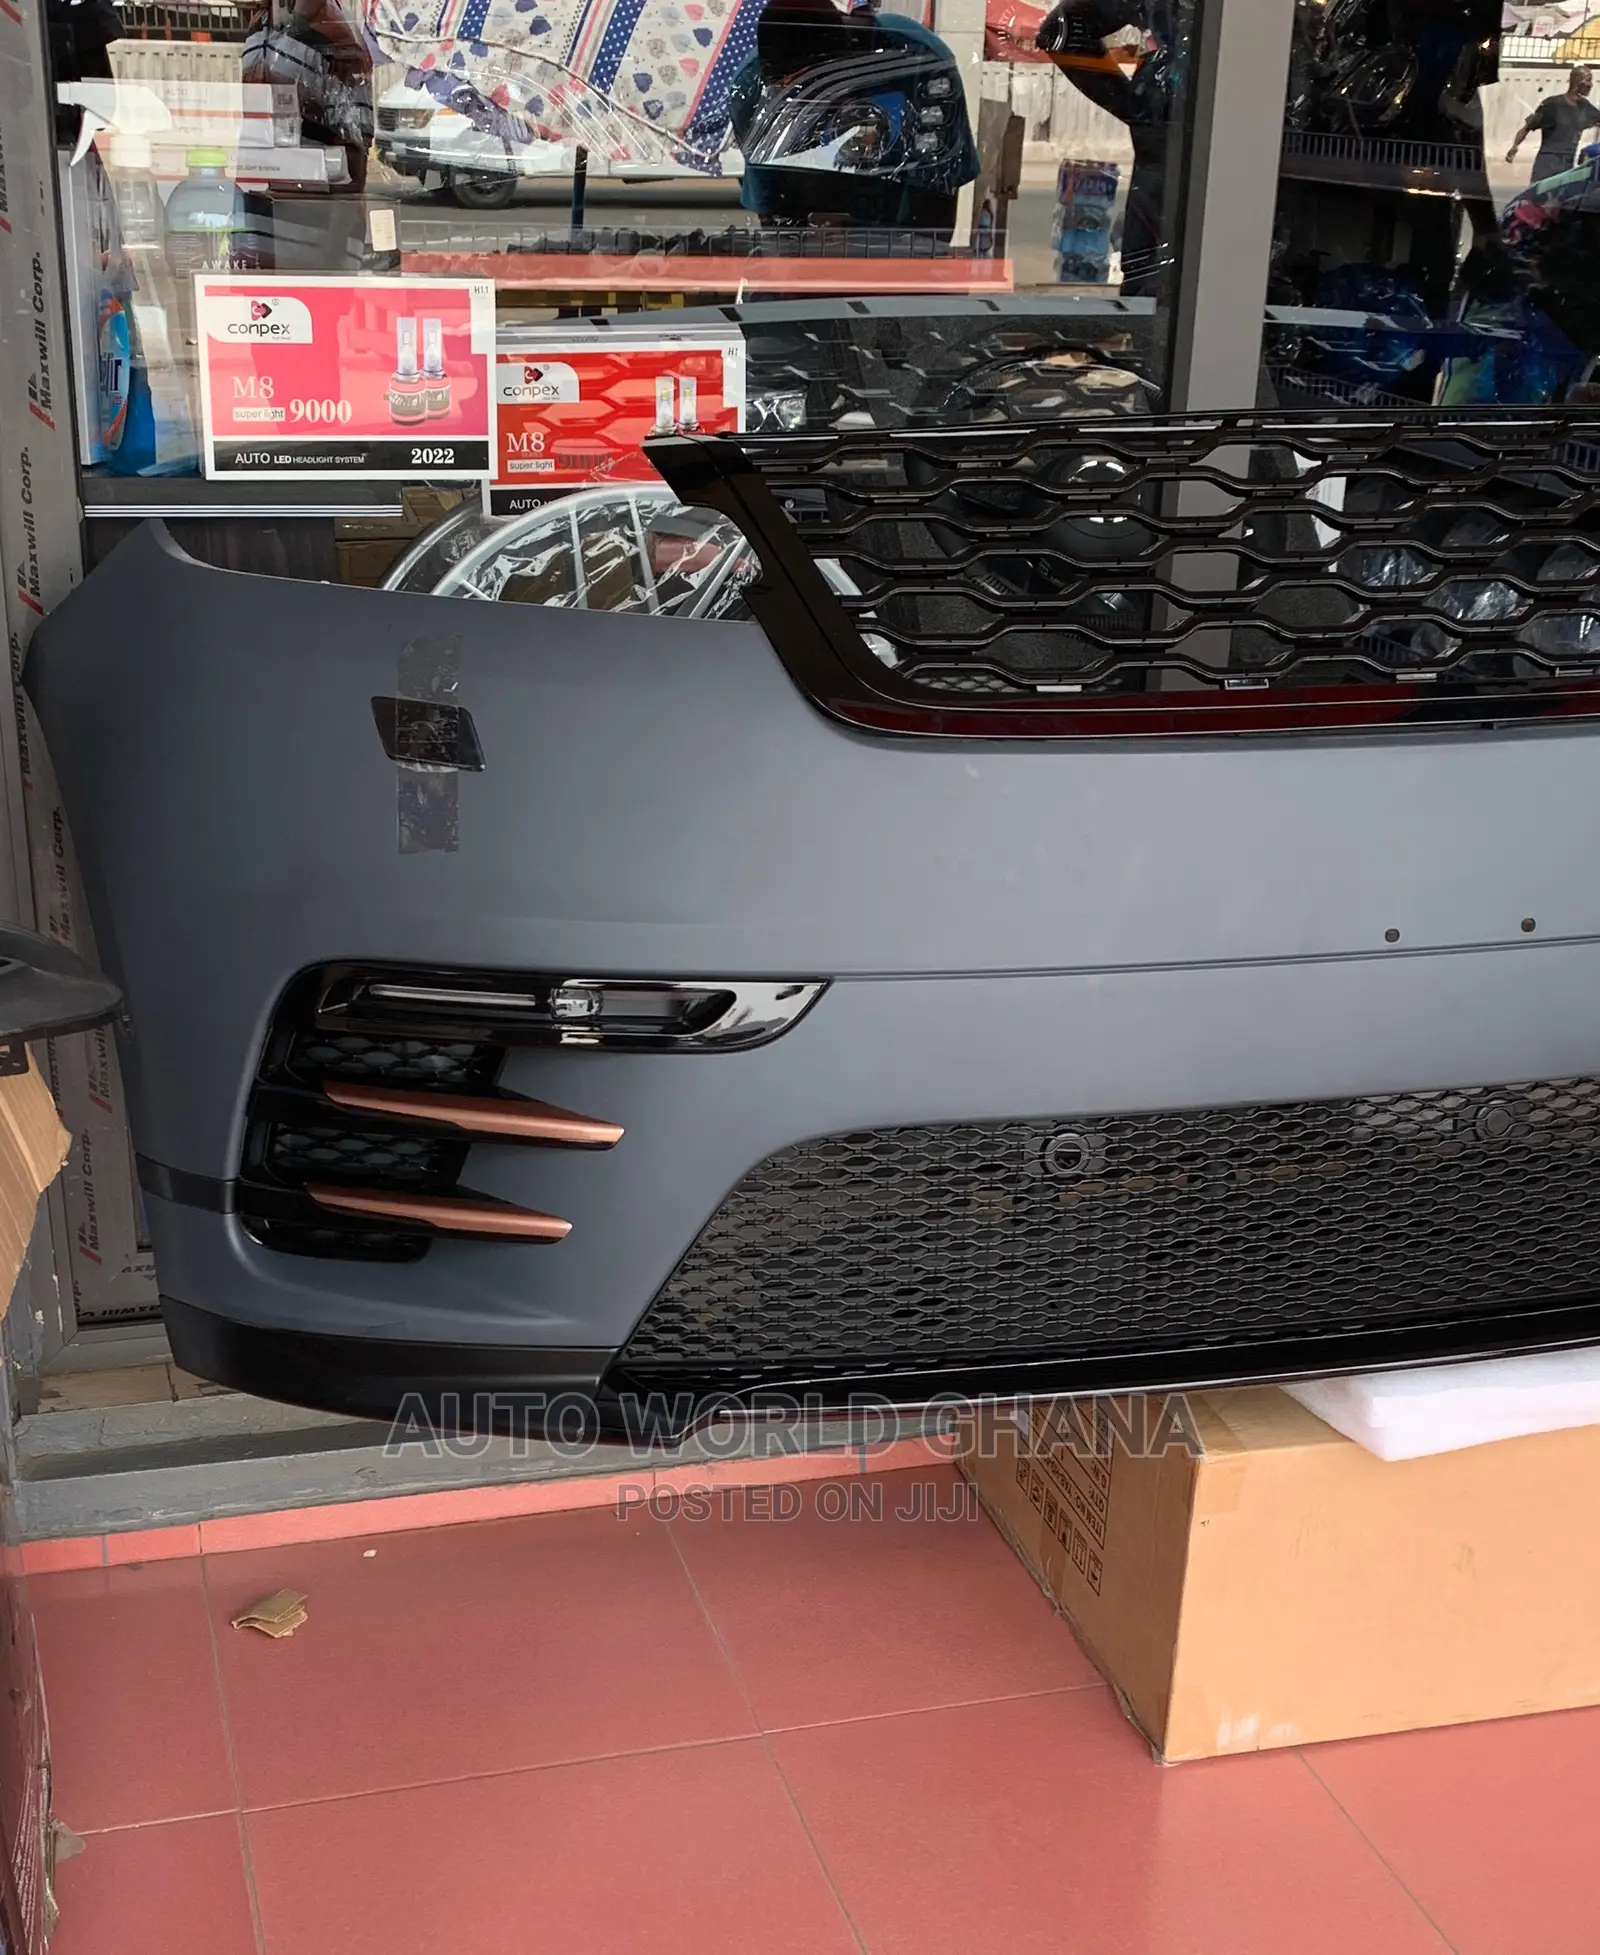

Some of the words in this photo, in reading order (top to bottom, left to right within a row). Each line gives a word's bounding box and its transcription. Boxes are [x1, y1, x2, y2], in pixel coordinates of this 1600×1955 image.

[202, 260, 247, 270] AWAKE
[32, 252, 46, 313] Corp.
[227, 323, 291, 337] conpex
[34, 318, 52, 411] Maxwill
[232, 376, 275, 399] M8
[503, 385, 560, 397] conpex
[235, 409, 262, 420] super
[263, 408, 284, 420] light
[289, 398, 353, 424] 9000
[506, 431, 546, 453] M8
[235, 453, 271, 465] AUTO
[274, 455, 292, 464] LED
[292, 456, 333, 464] HEADLIGHT
[335, 455, 365, 464] SYSTEM
[411, 448, 455, 464] 2022
[509, 462, 533, 471] super
[535, 460, 553, 470] light
[21, 446, 33, 504] Corp.
[510, 498, 541, 509] AUTO
[23, 510, 41, 597] Maxwill
[52, 806, 64, 858] Corp.
[81, 1129, 92, 1177] Corp.
[84, 1181, 99, 1251] Maxwill
